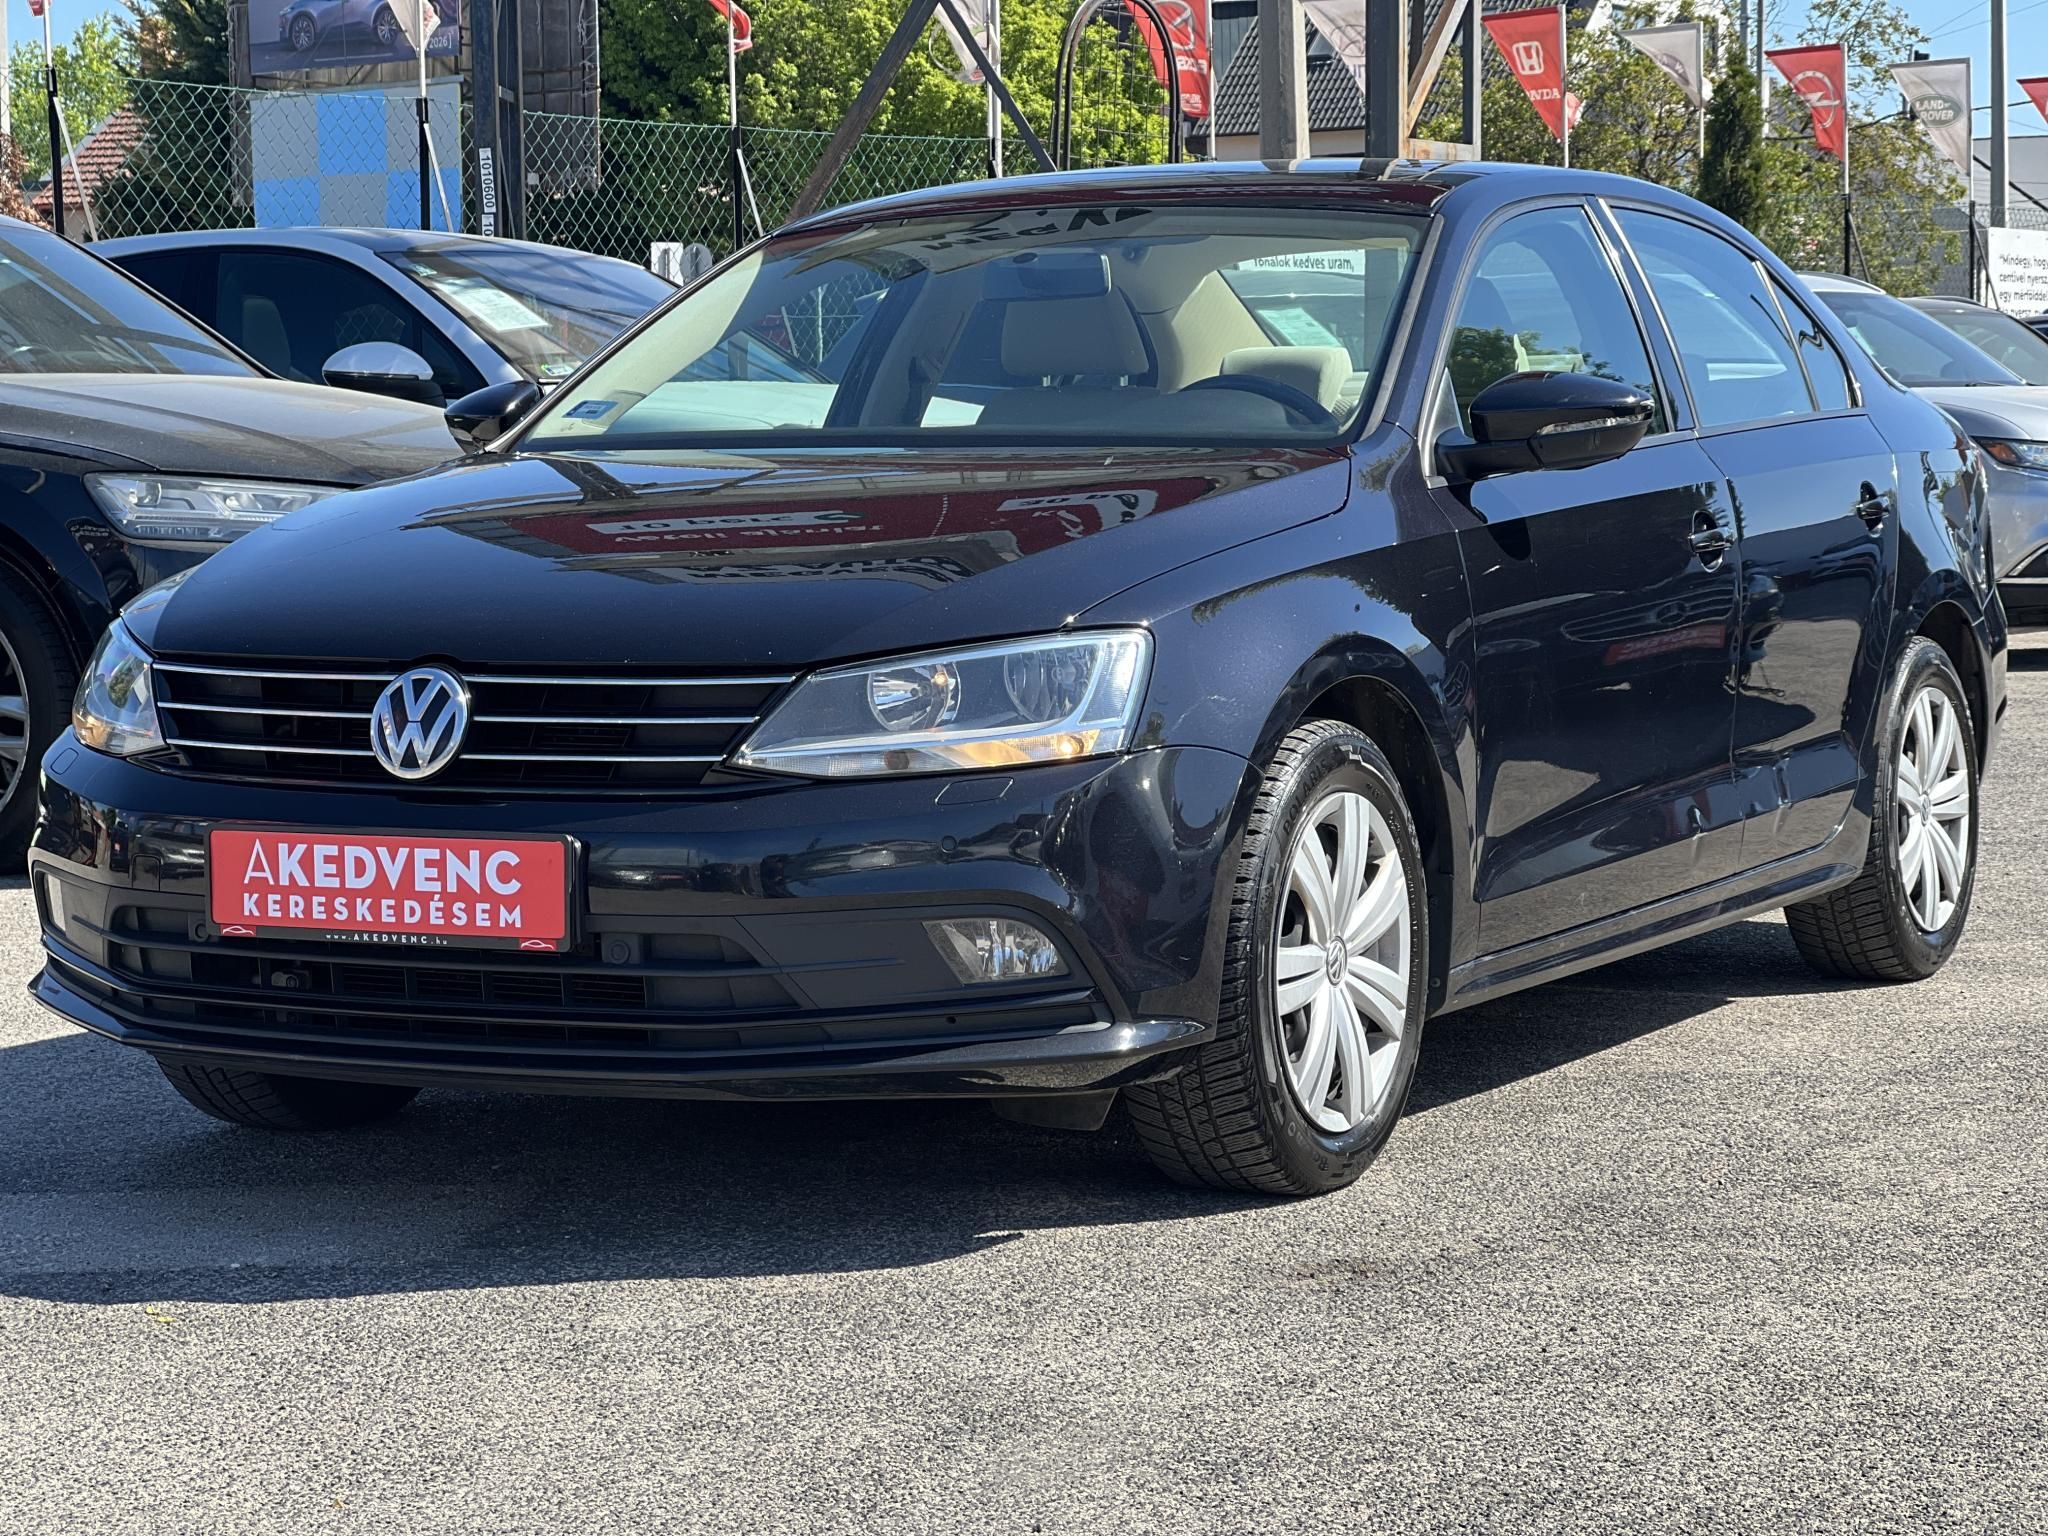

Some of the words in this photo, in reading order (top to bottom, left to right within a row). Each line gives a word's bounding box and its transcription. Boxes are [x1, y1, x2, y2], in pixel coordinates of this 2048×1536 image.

[1527, 88, 1561, 100] NDA
[1293, 255, 1325, 269] kedves
[244, 838, 522, 895] AKEDVENC
[243, 892, 522, 928] KERESKEDÉSEM
[326, 933, 448, 946] www.AKEDVENC.hu
